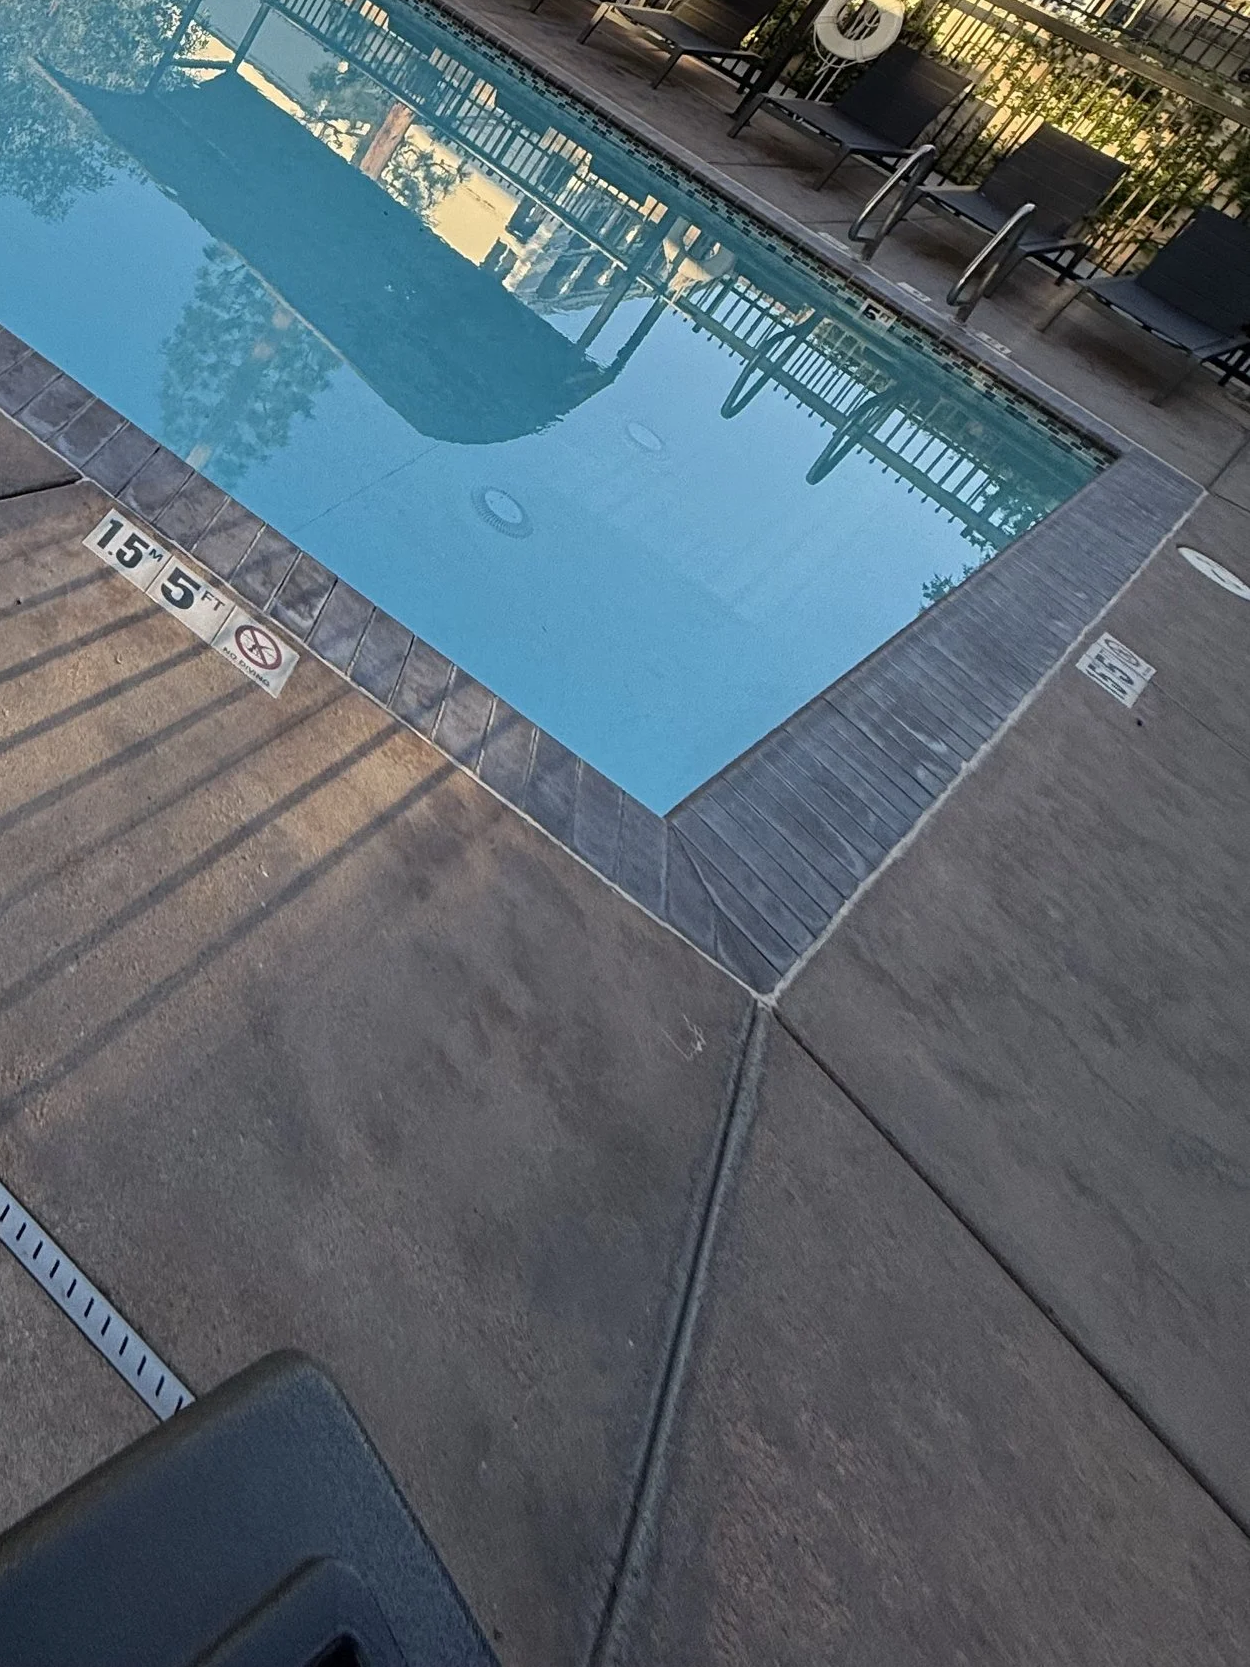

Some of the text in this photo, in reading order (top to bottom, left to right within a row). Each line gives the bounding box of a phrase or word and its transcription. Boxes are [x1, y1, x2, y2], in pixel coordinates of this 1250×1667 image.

[862, 304, 881, 321] 5
[97, 518, 164, 569] 1.5 M
[160, 566, 225, 611] 5 FT
[222, 646, 270, 687] NO DIVING
[1095, 653, 1135, 685] 5
